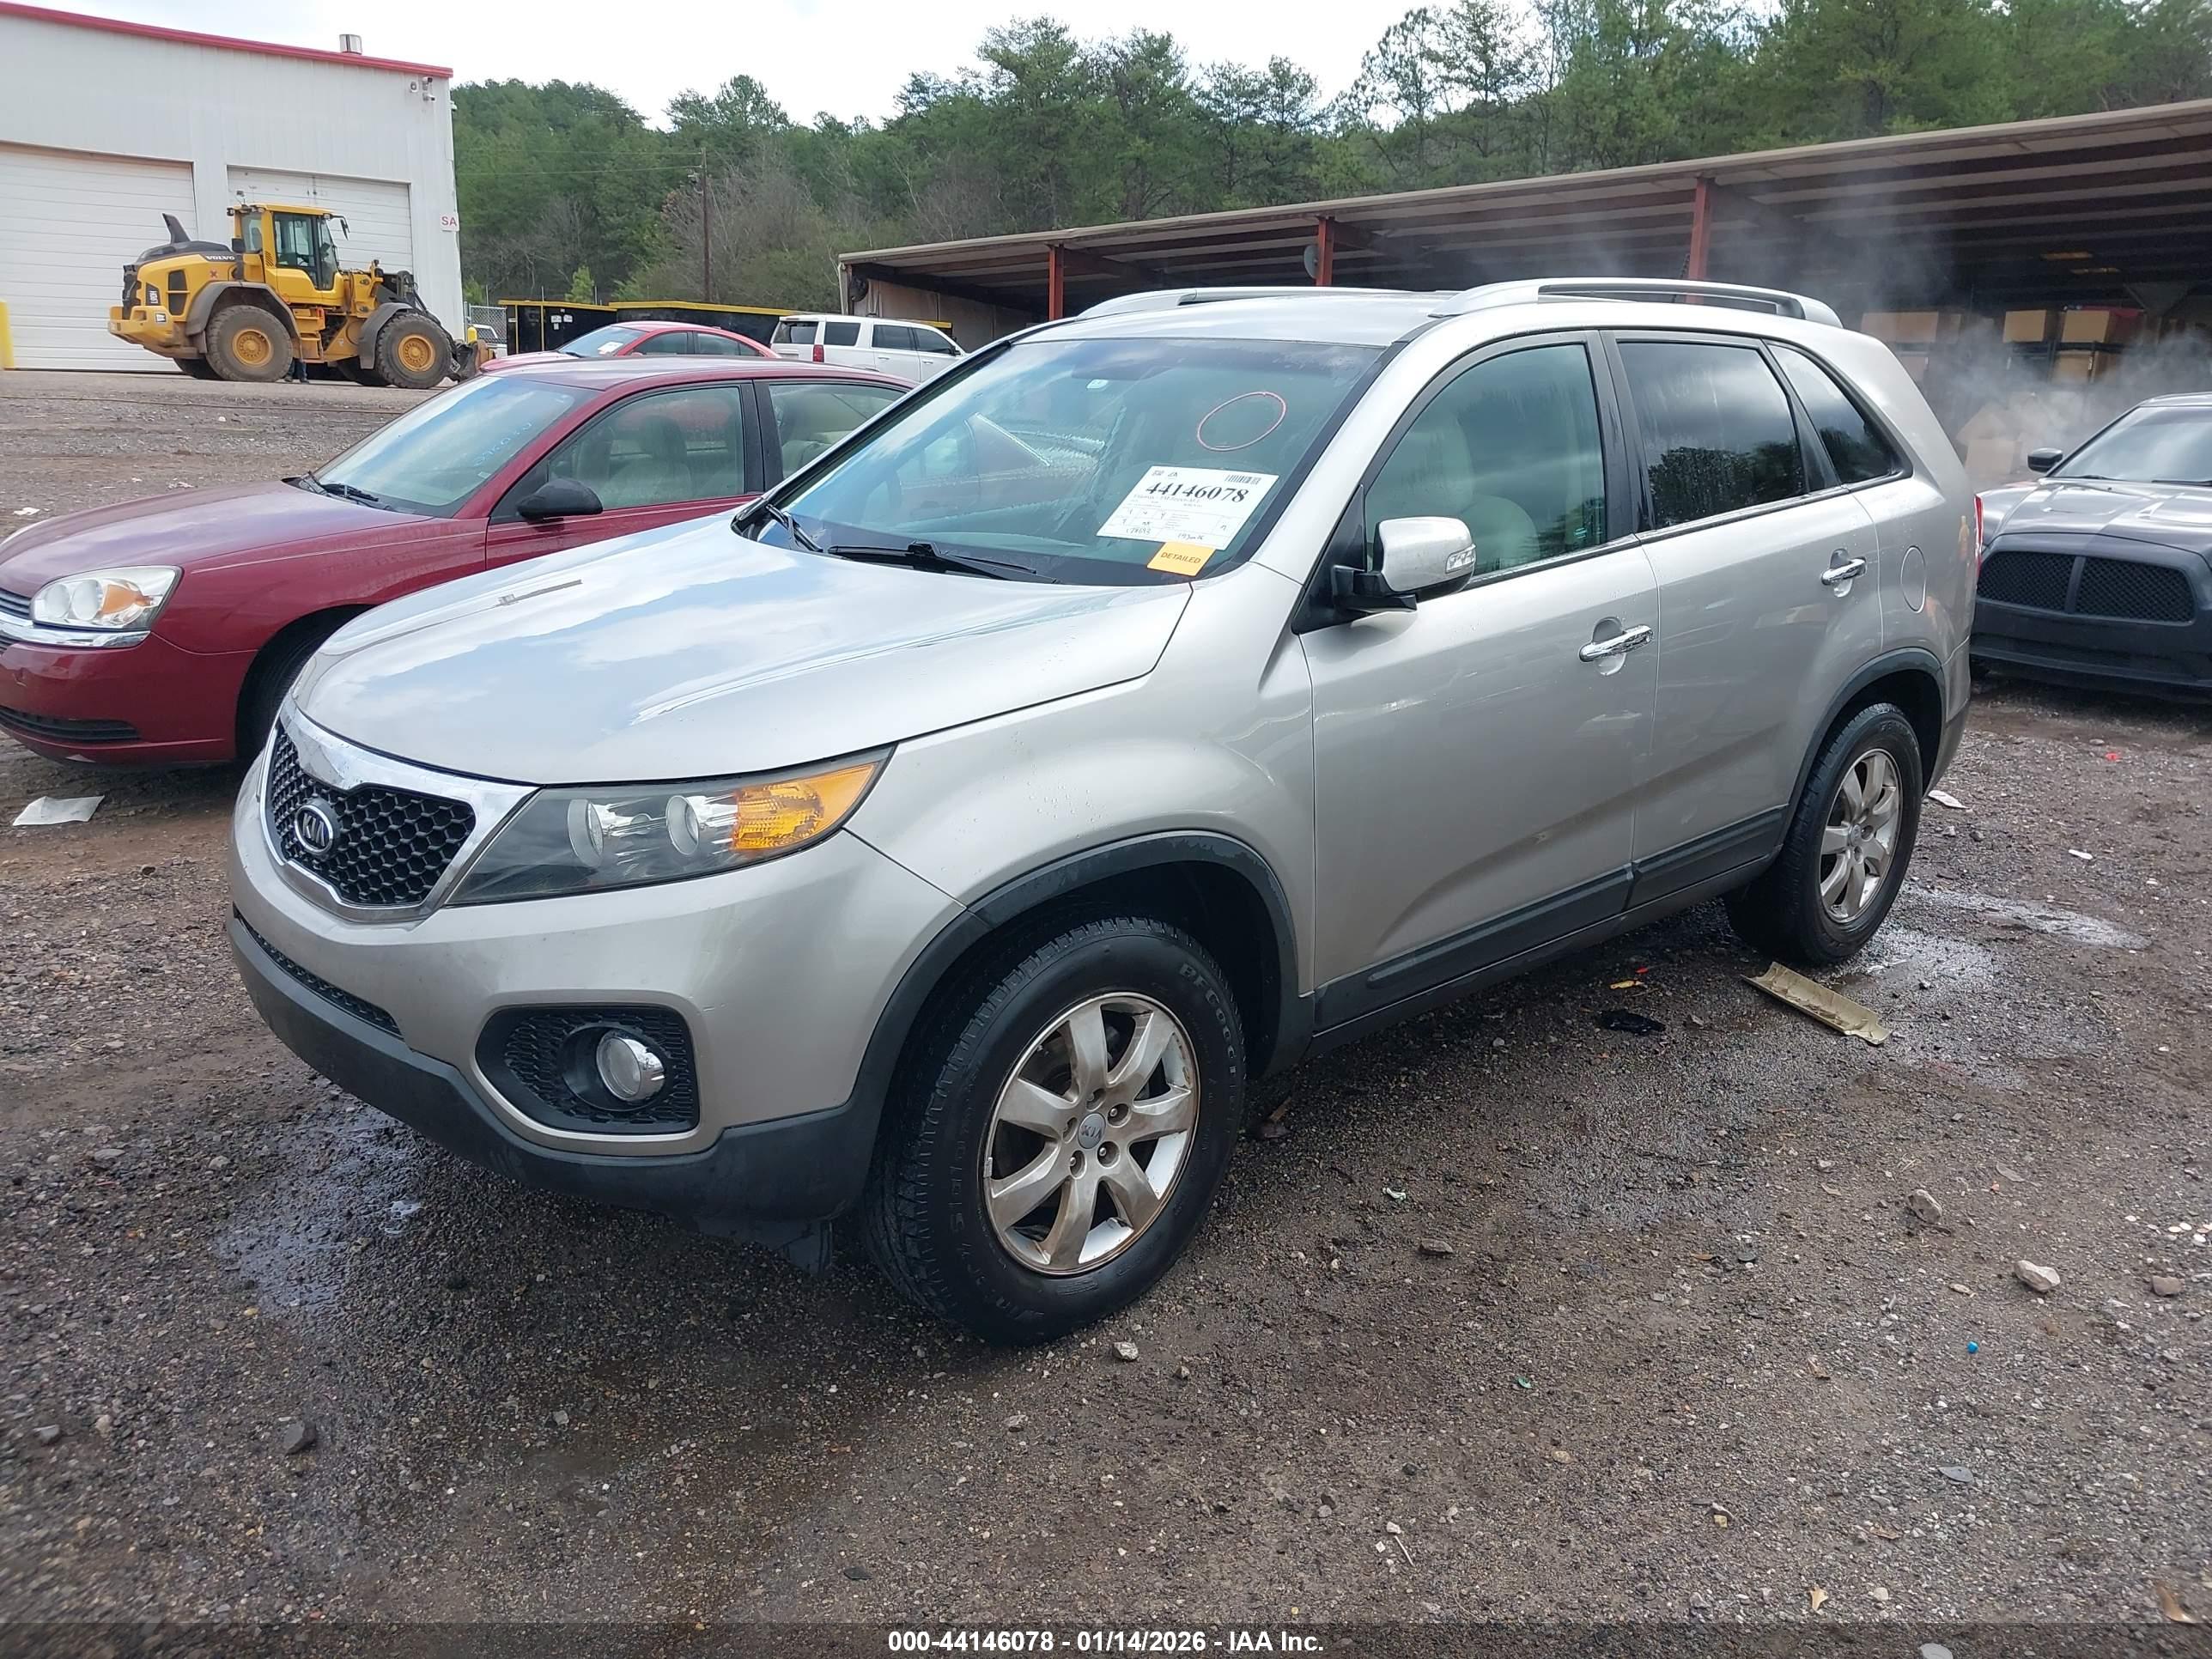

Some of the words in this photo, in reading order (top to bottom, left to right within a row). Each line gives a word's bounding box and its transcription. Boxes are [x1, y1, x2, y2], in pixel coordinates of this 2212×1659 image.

[441, 216, 458, 226] SA
[1146, 482, 1249, 503] 44146078
[1160, 551, 1201, 564] DETAILED
[302, 812, 325, 847] KIA
[1081, 1125, 1103, 1140] KIA
